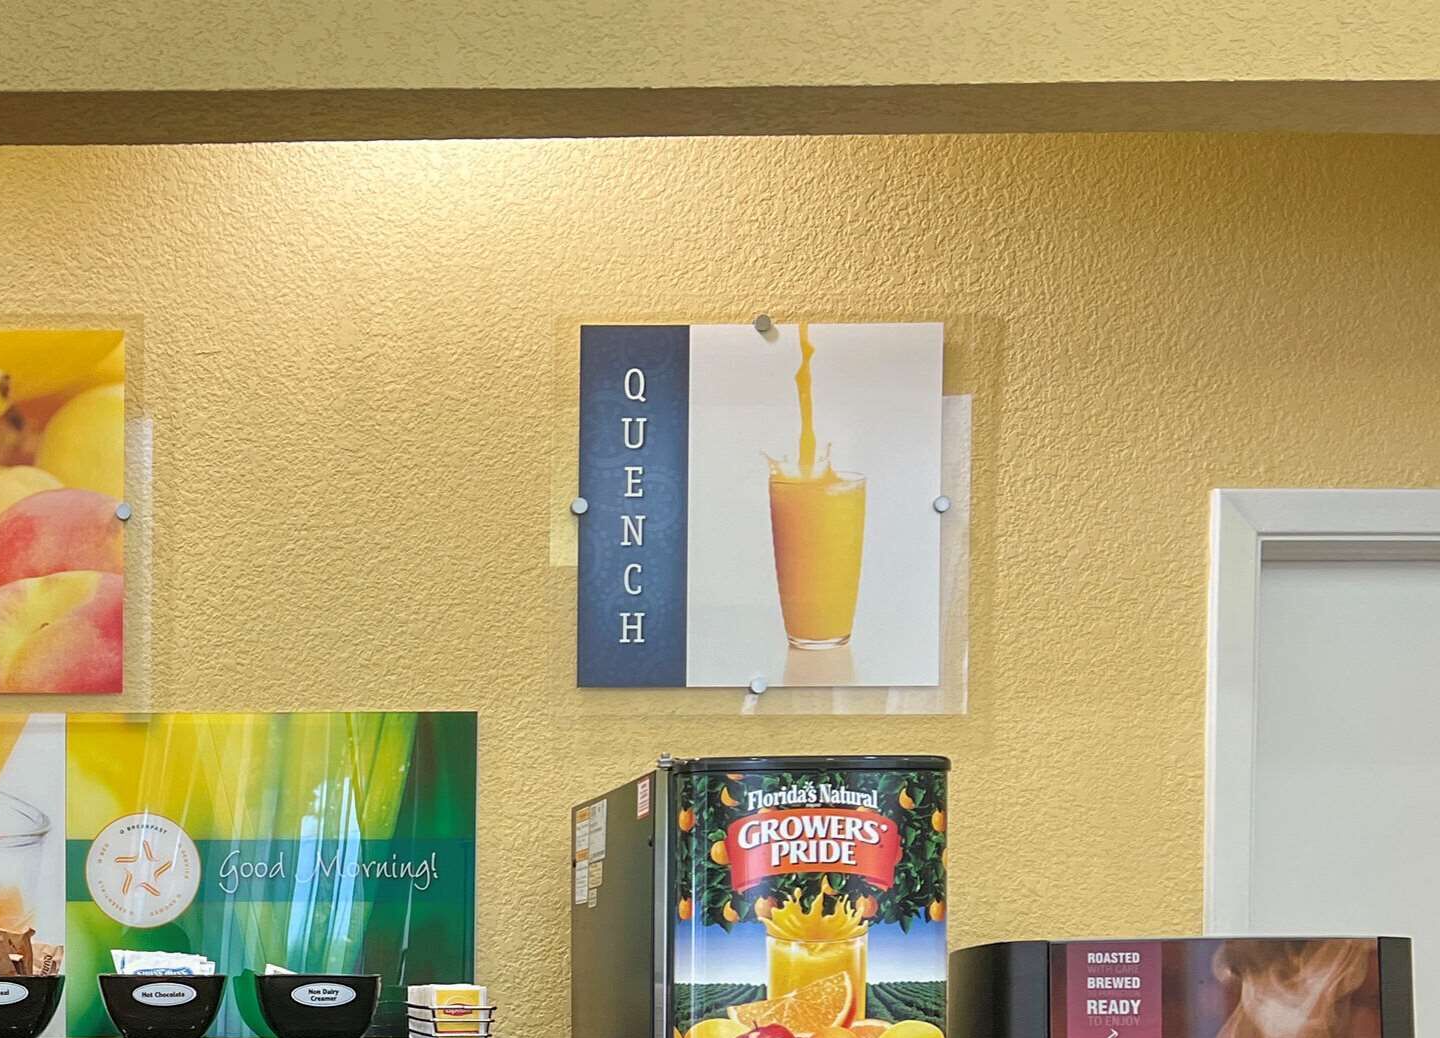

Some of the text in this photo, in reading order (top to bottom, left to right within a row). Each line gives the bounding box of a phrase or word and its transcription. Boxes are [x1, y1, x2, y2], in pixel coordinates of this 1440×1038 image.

[619, 368, 647, 644] QUENCH
[747, 782, 879, 811] Florida's Natural
[771, 840, 857, 867] PRIDE
[219, 850, 285, 893] Good
[295, 849, 438, 890] Morning!
[1087, 952, 1140, 964] ROASTED
[322, 988, 340, 996] Dairy
[1087, 977, 1140, 989] BREWED
[1087, 1000, 1141, 1014] READY
